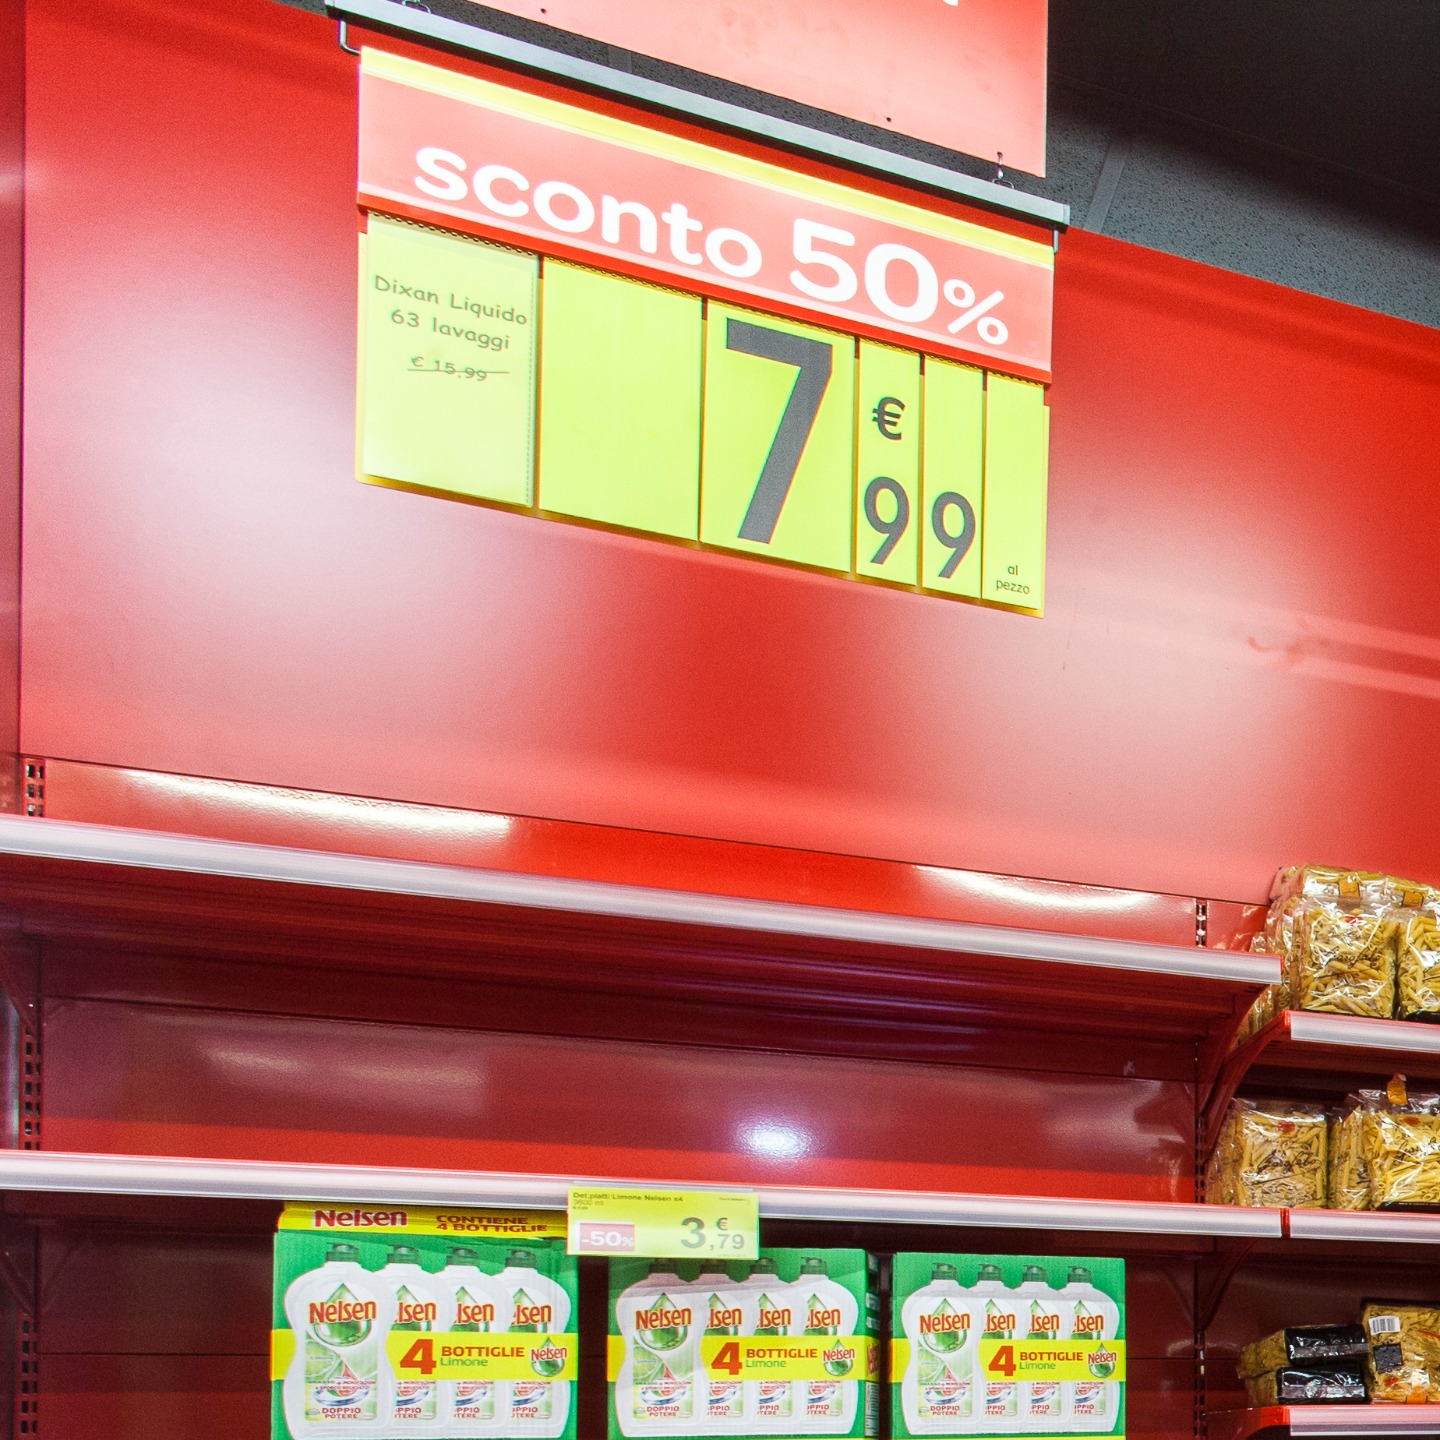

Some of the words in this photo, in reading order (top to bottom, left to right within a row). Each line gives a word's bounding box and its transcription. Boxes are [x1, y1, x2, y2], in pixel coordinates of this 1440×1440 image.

[414, 147, 763, 278] sconto
[789, 217, 1008, 346] 50%
[374, 275, 439, 305] Dixan
[449, 293, 528, 327] Liquido
[390, 309, 420, 329] 63
[432, 317, 510, 354] lavaggi
[726, 317, 834, 545] 7
[1006, 563, 1019, 577] al
[995, 578, 1031, 596] pezzo
[314, 1209, 408, 1227] Nelsen
[436, 1214, 529, 1225] CONTIENE
[449, 1223, 548, 1233] BOTTIGLIE
[309, 1300, 377, 1324] Nelsen
[400, 1338, 437, 1375] 4
[441, 1345, 525, 1358] BOTTIGLIE
[440, 1356, 489, 1368] Limone
[530, 1345, 568, 1362] Nelsen
